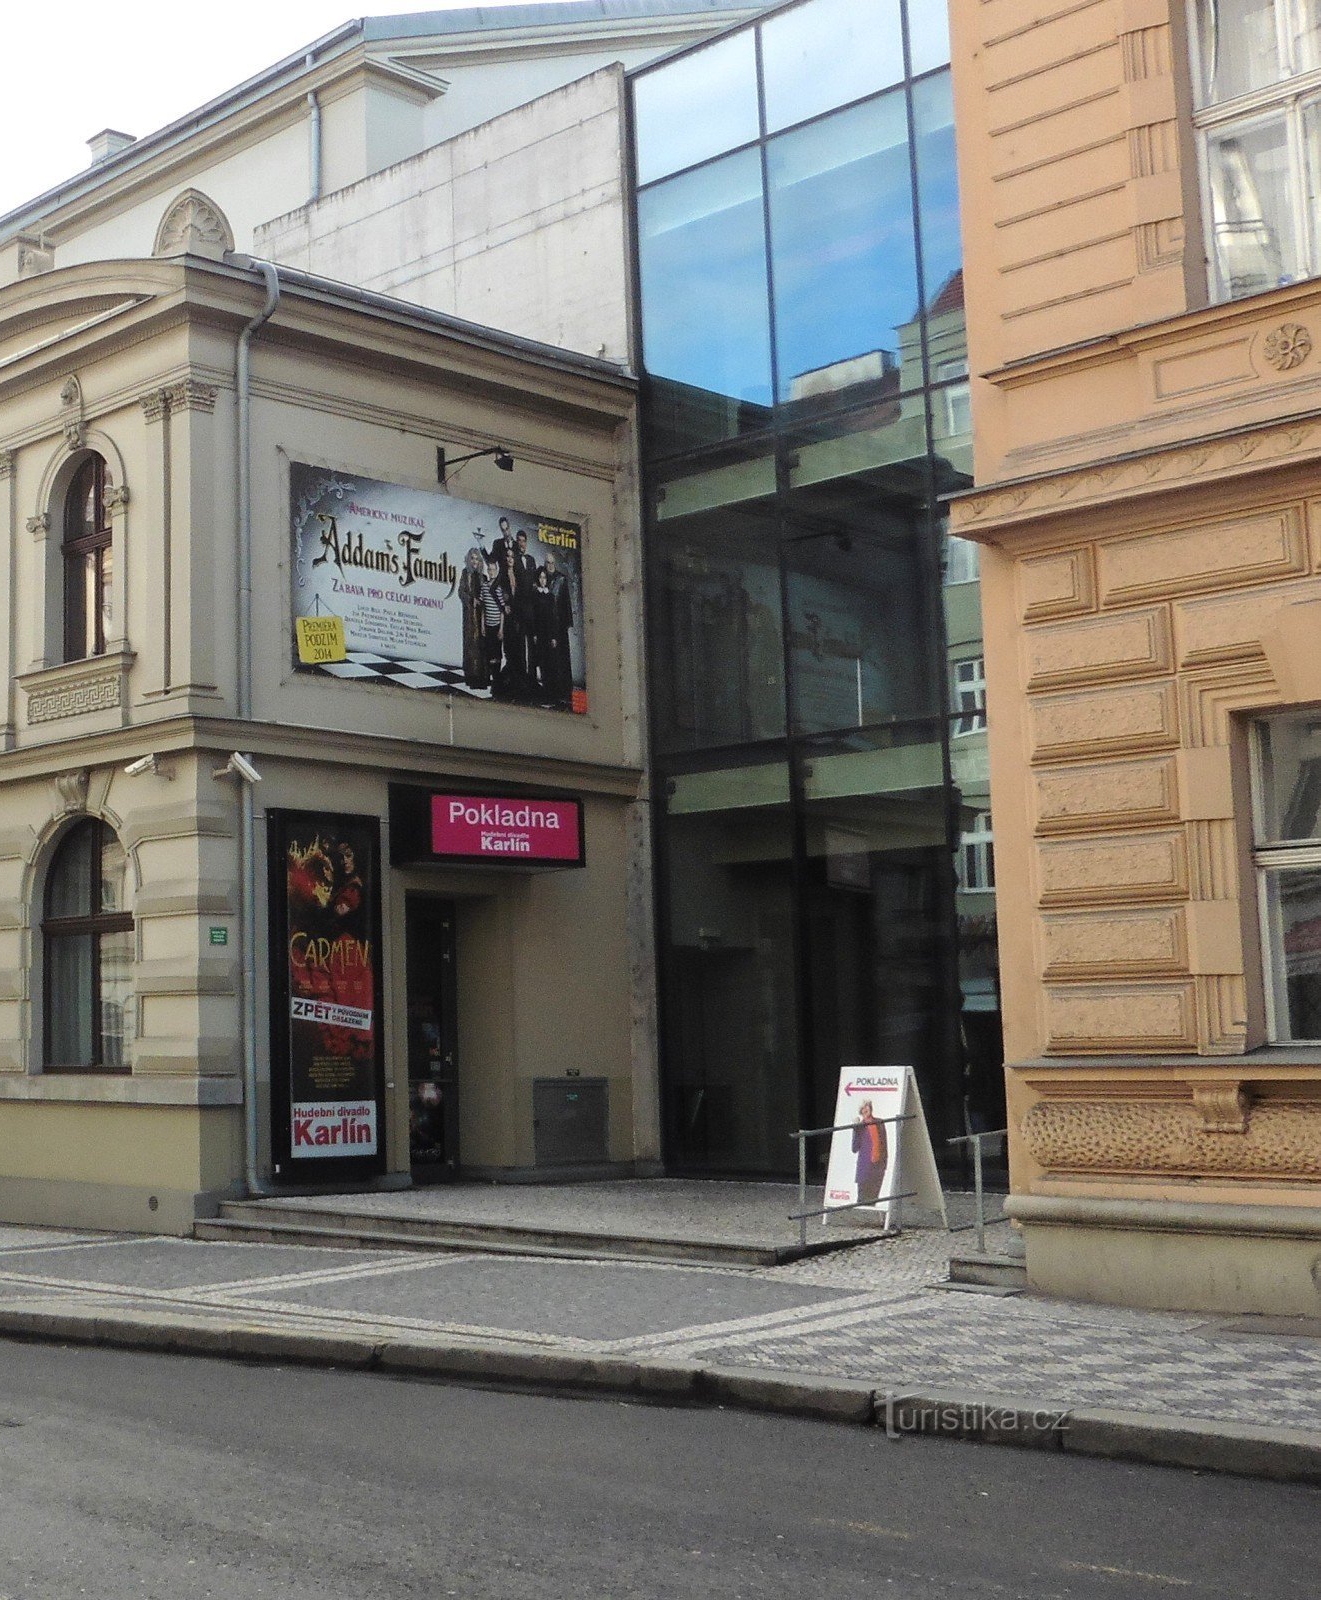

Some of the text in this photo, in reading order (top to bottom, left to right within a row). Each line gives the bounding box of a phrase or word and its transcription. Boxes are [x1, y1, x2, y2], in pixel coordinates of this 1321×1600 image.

[397, 530, 457, 600] Family
[384, 590, 411, 604] CELOU
[413, 595, 444, 610] RODINU
[305, 632, 338, 647] PODZIM
[314, 648, 332, 660] 2014
[449, 801, 560, 829] Pokladna
[289, 932, 369, 974] CARMEN
[856, 1077, 898, 1086] POKLADNA
[337, 1106, 370, 1117] divadlo
[293, 1117, 372, 1147] Karlín
